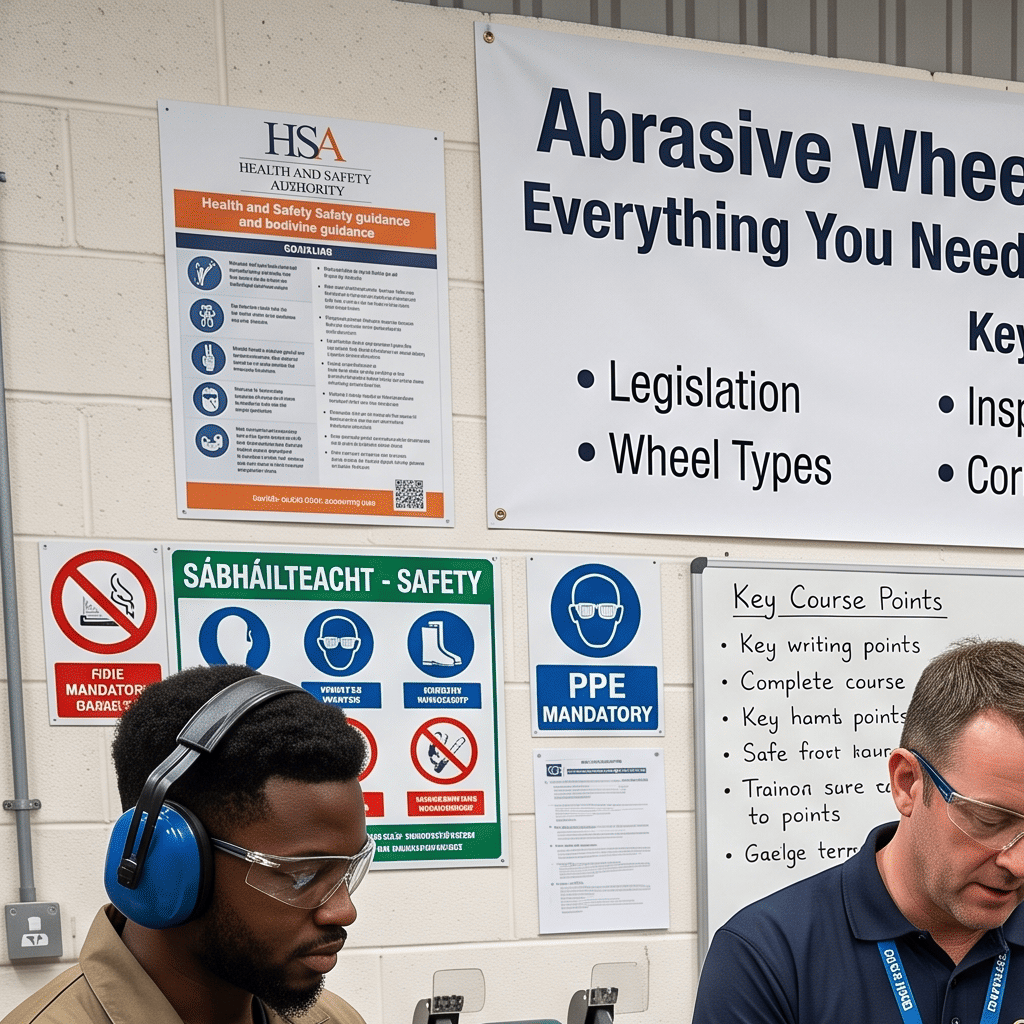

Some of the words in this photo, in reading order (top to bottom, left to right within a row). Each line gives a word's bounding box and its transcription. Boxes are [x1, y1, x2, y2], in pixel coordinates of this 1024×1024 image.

[264, 121, 346, 162] HSA
[537, 88, 832, 183] Abrasive
[239, 162, 290, 178] HEALTH
[293, 168, 321, 180] AND
[324, 170, 372, 185] SAFETY
[201, 197, 243, 212] Health
[247, 201, 270, 214] and
[273, 203, 312, 219] Safety
[355, 211, 410, 227] guidance
[523, 180, 789, 267] Everything
[805, 211, 892, 266] You
[239, 217, 262, 229] and
[320, 223, 375, 239] guidance
[609, 360, 801, 414] Legislation
[609, 433, 720, 479] Wheel
[732, 440, 832, 492] Types
[183, 556, 374, 592] SÁBHÁILTEACHT
[397, 568, 482, 595] SAFETY
[733, 583, 776, 620] Key
[790, 584, 866, 610] Course
[879, 586, 943, 611] Points
[740, 632, 777, 662] Key
[787, 636, 852, 663] writing
[864, 635, 920, 660] points
[65, 683, 147, 696] MANDATOR
[569, 672, 626, 698] PPE
[740, 670, 834, 698] Complete
[846, 676, 906, 690] course
[542, 706, 653, 723] MANDATORY
[742, 706, 779, 734] Key
[854, 705, 907, 732] points
[743, 741, 788, 763] Safe
[824, 782, 864, 795] sure
[749, 807, 770, 825] to
[782, 803, 841, 831] points
